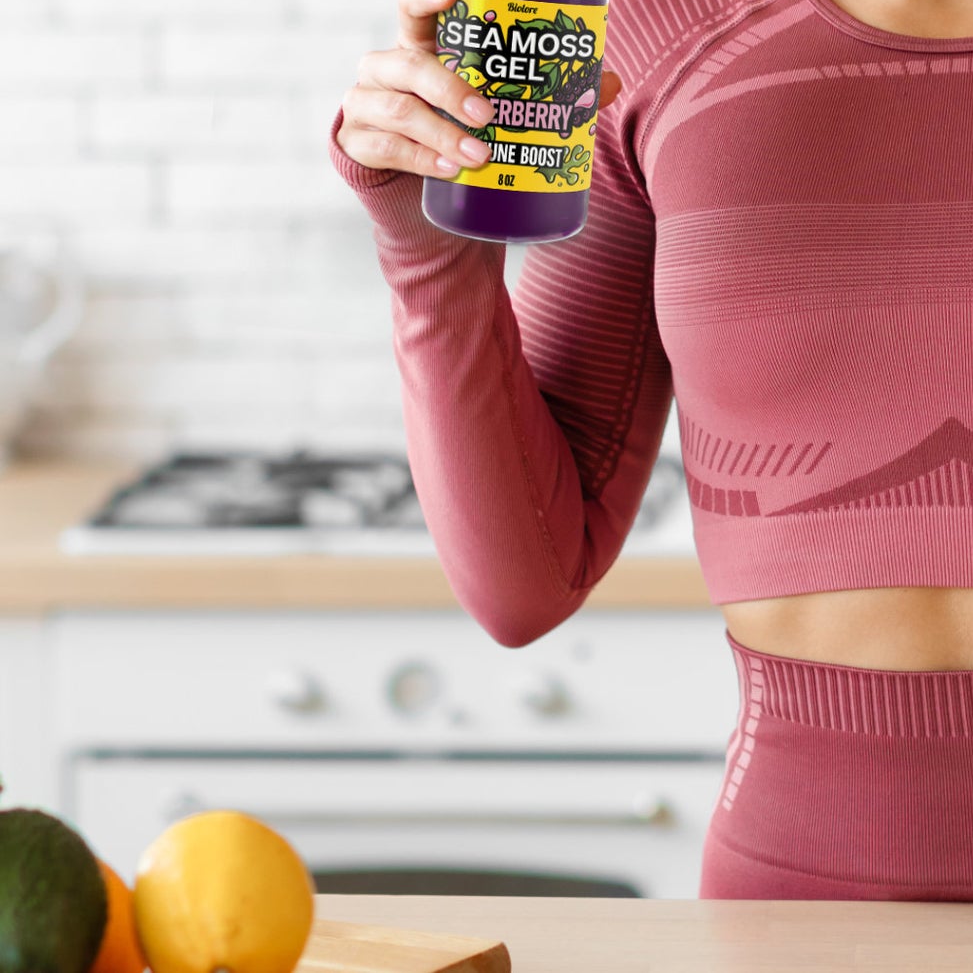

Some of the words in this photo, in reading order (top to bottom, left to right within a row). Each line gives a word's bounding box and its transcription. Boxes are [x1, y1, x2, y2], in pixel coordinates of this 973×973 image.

[445, 21, 503, 51] SEA
[510, 30, 595, 58] MOSS
[485, 54, 545, 82] GEL
[490, 98, 574, 131] ERBERRY
[489, 142, 516, 163] UNE
[520, 145, 563, 168] BOOST
[498, 173, 504, 186] 8
